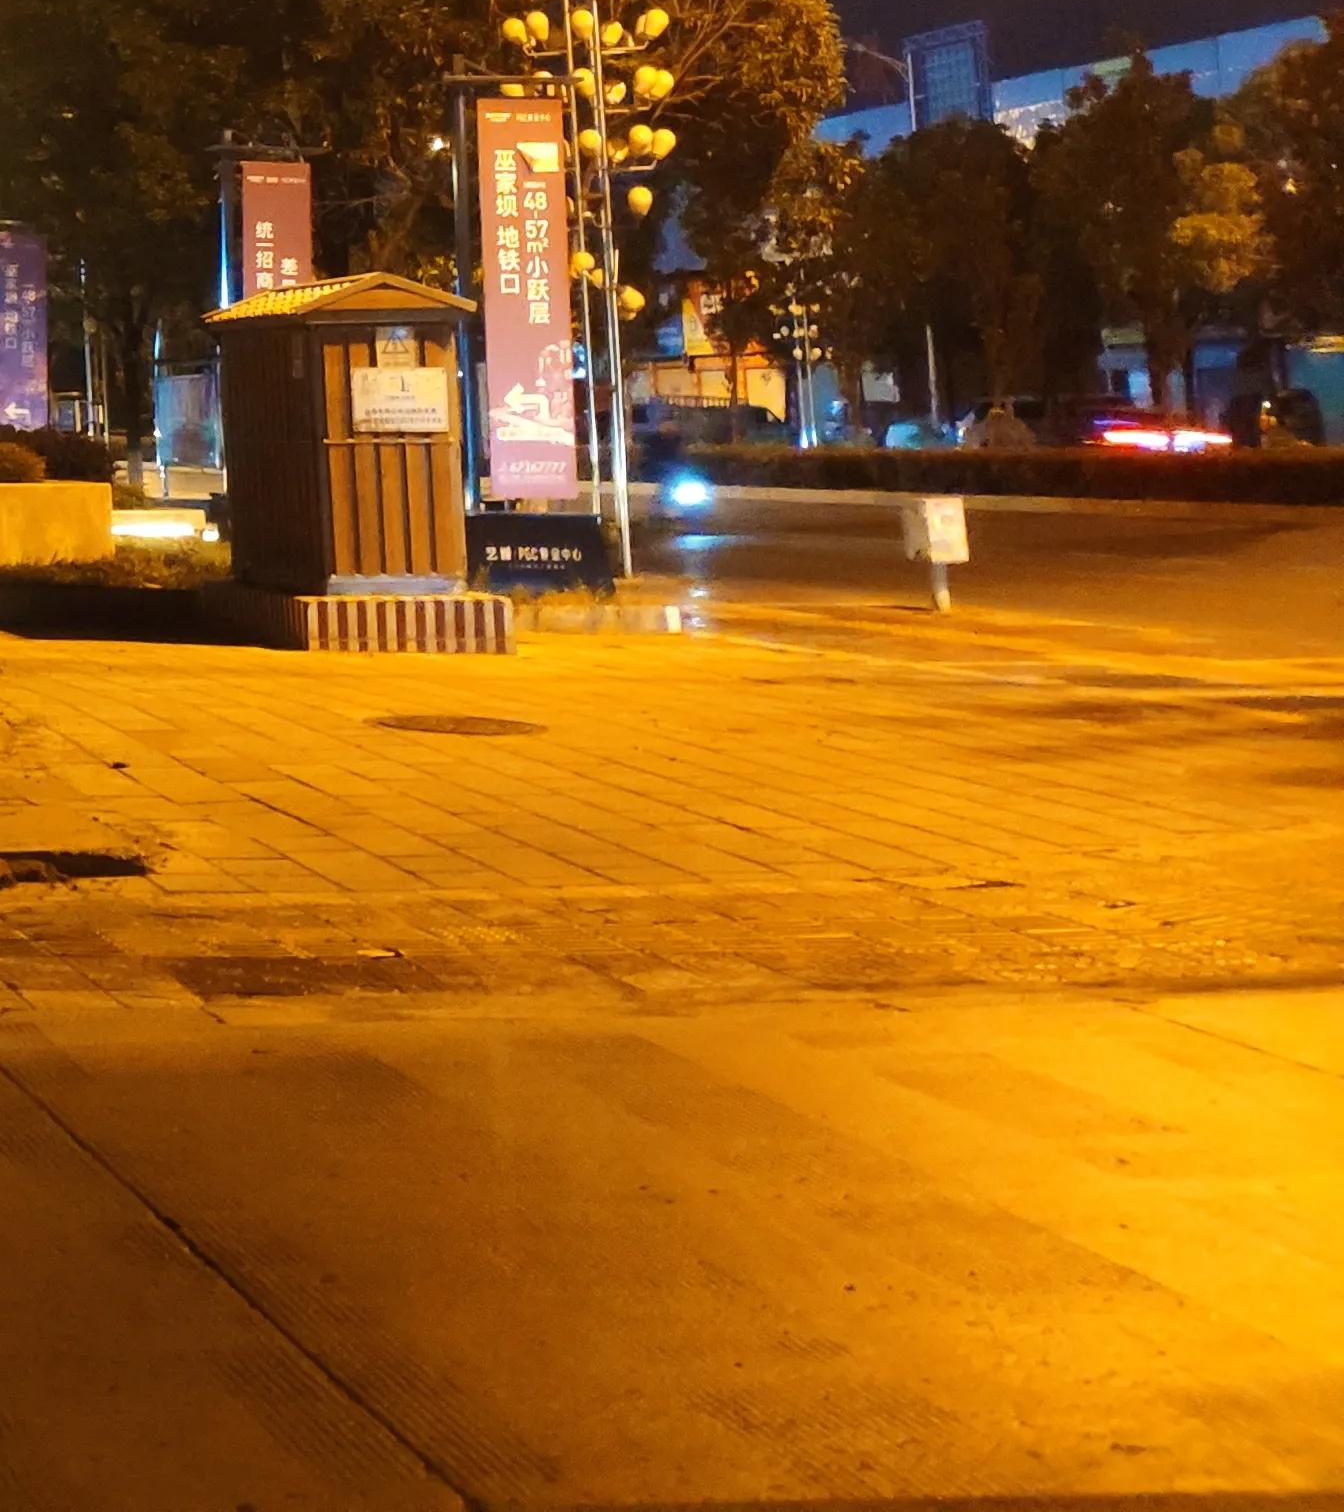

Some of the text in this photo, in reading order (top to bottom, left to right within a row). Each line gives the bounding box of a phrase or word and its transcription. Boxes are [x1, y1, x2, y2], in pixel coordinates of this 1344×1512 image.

[494, 149, 519, 217] 巫家坝
[255, 221, 274, 289] 统一招商
[497, 225, 521, 295] 地铁口
